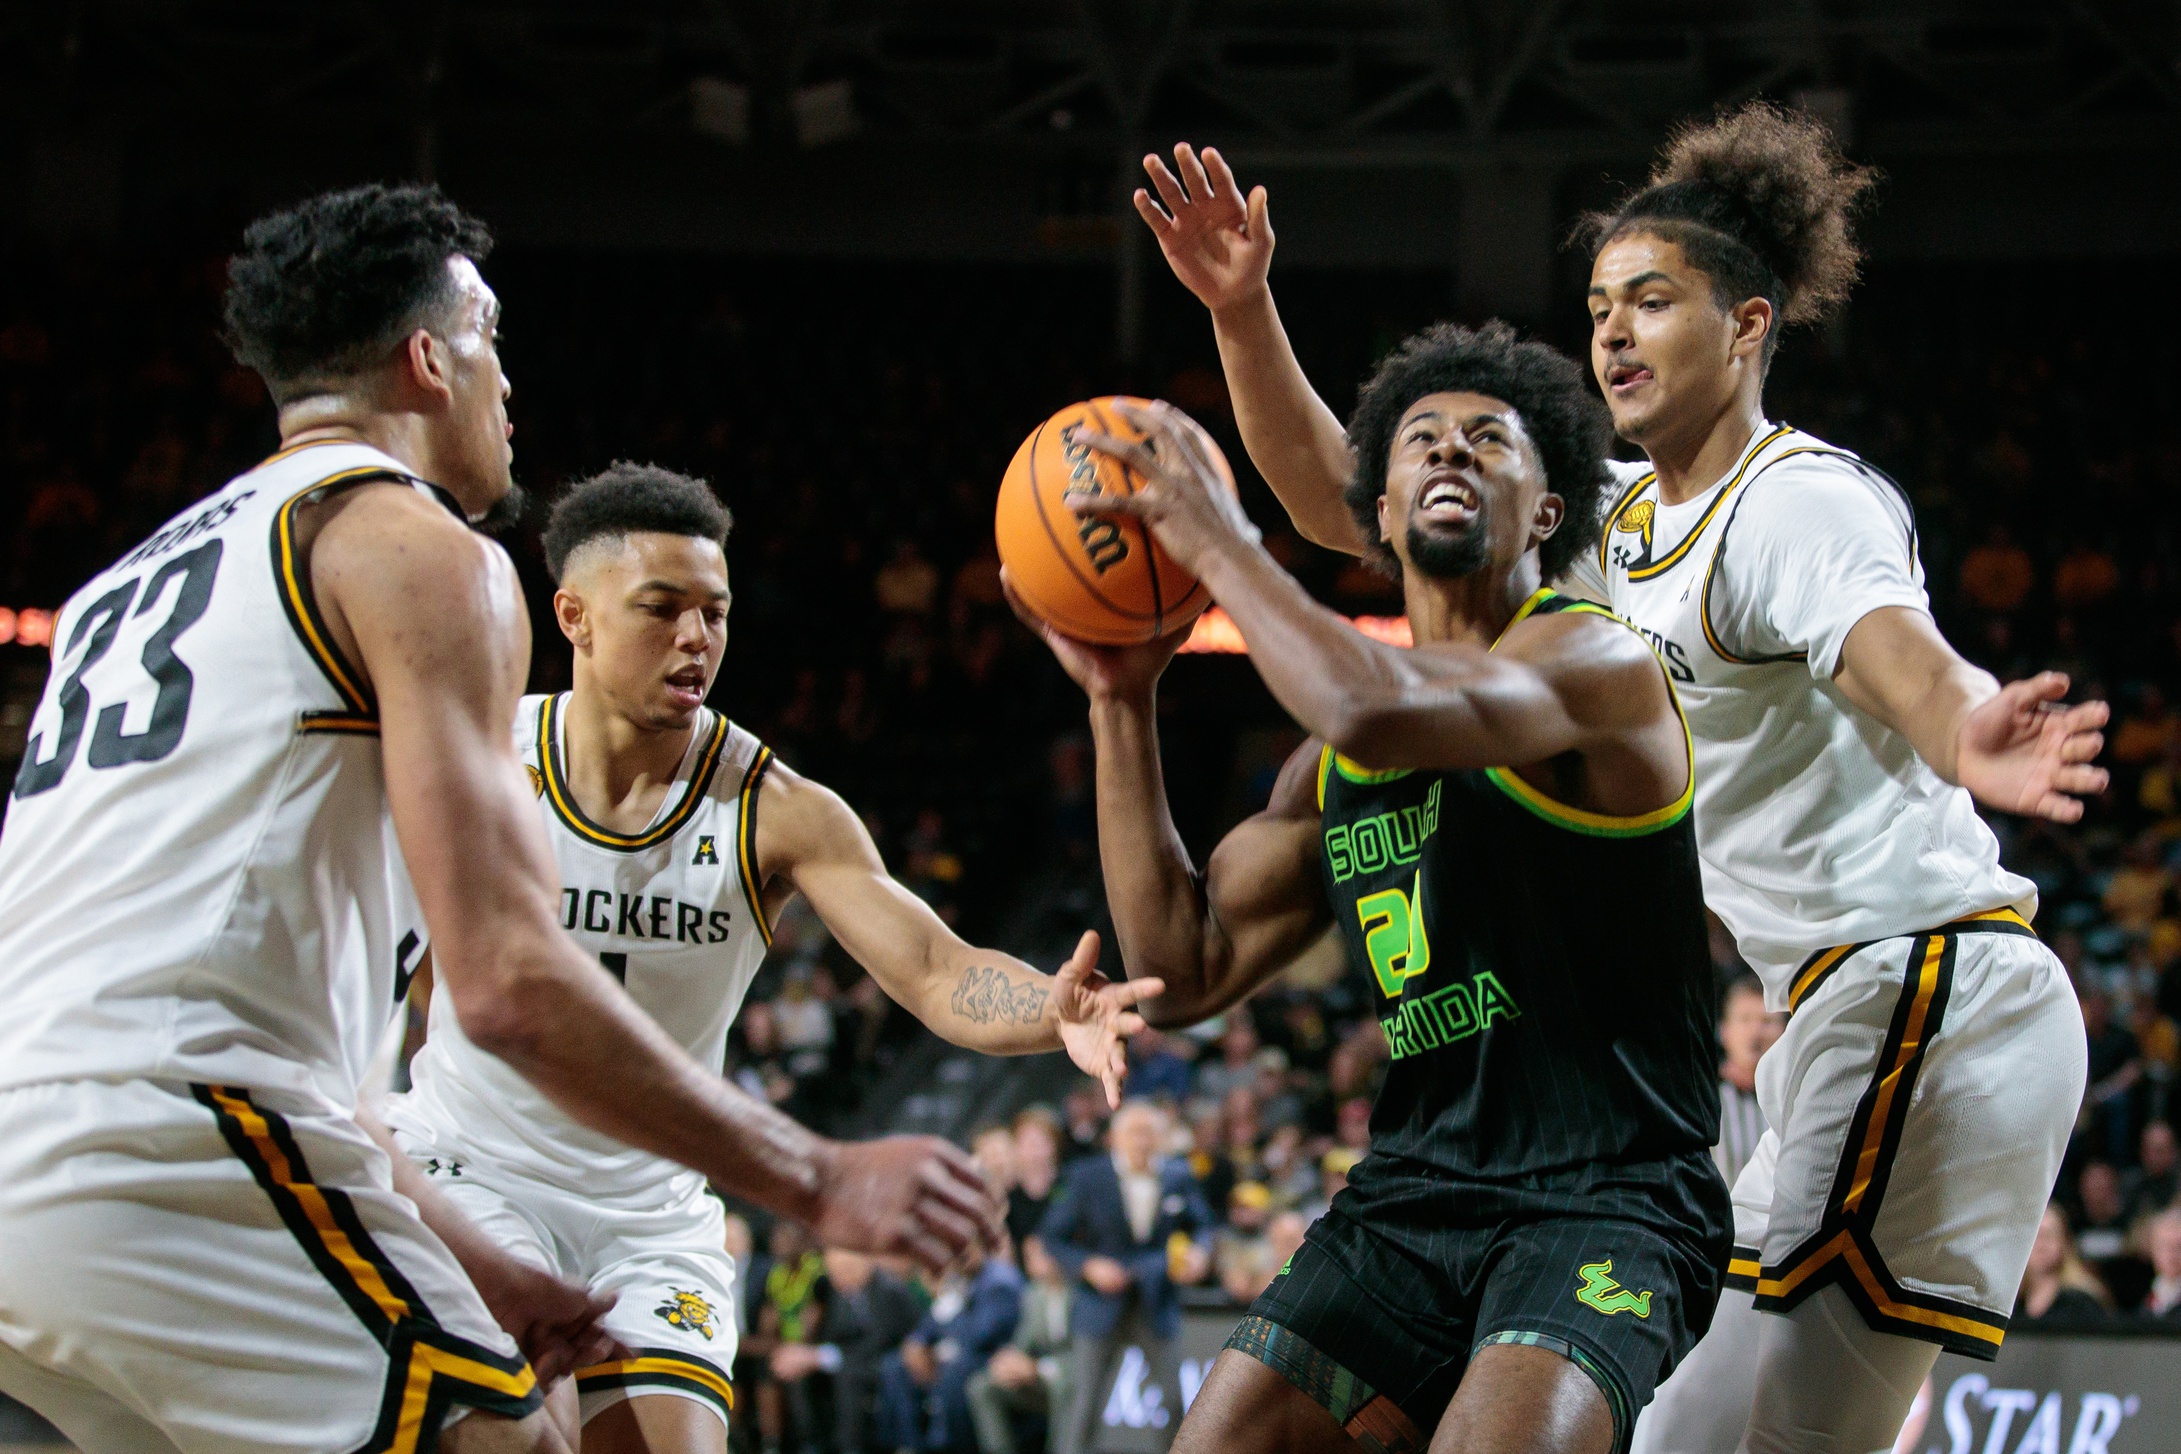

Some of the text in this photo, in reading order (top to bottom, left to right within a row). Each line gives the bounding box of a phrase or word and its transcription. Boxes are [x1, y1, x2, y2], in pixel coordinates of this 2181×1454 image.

[1060, 418, 1129, 575] WSON
[14, 538, 223, 799] 33
[1326, 779, 1442, 885] SOUH
